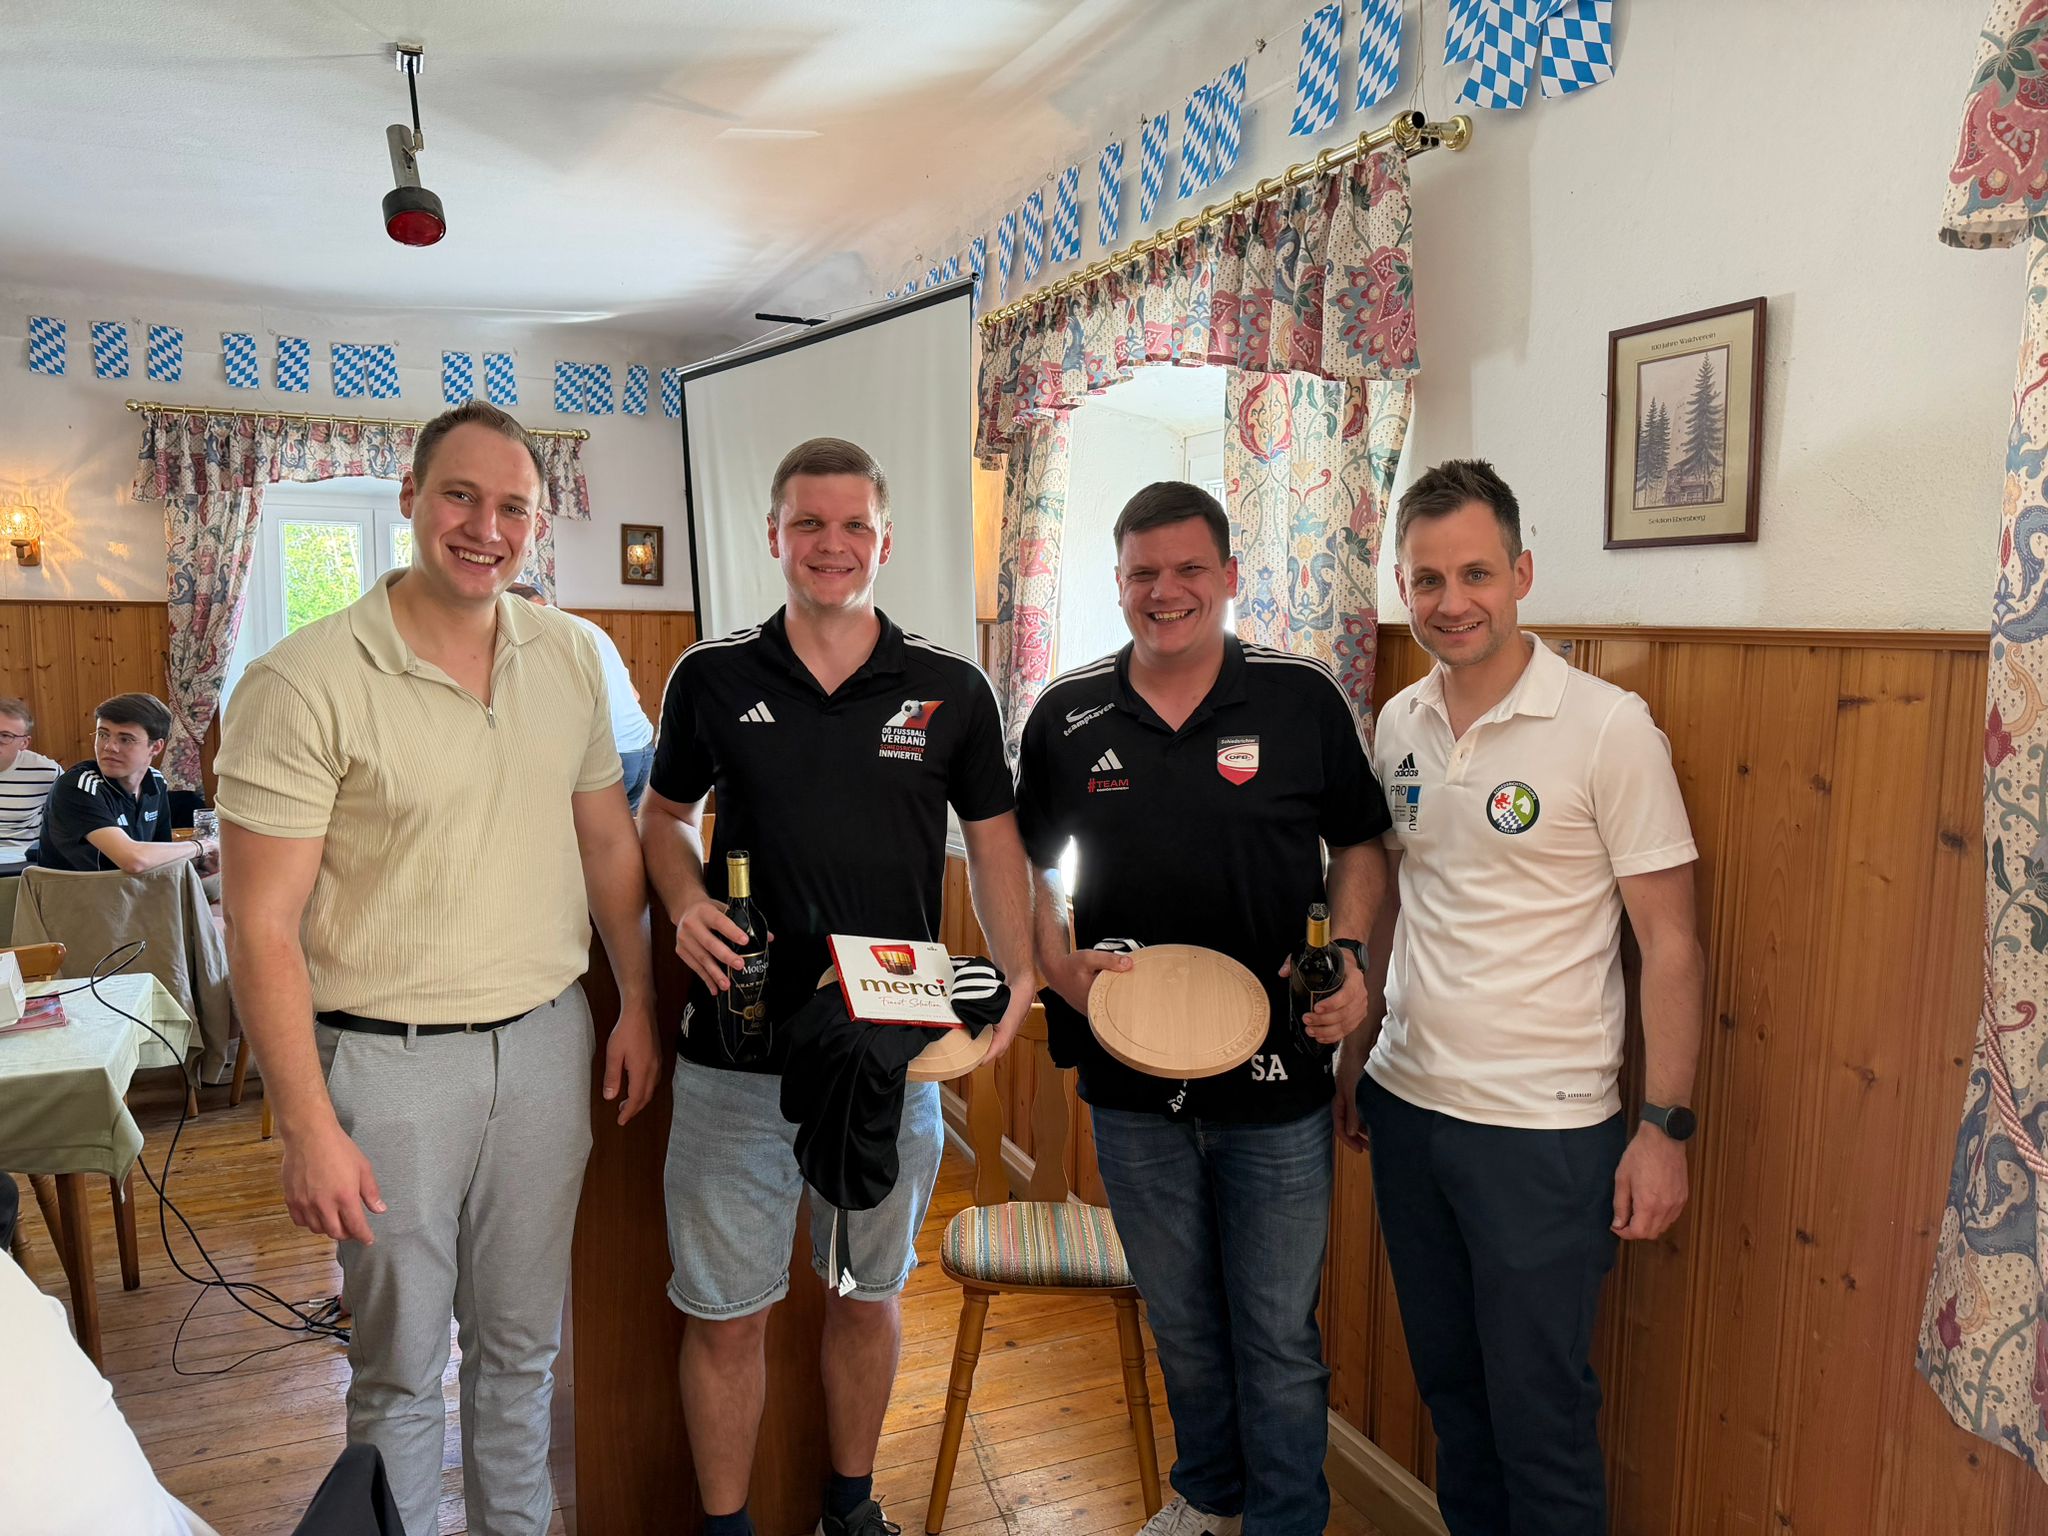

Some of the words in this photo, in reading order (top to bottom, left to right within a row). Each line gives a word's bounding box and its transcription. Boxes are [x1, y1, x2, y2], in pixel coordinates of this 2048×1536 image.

[881, 733, 926, 747] VERBAND
[893, 728, 926, 738] FUSSBALL
[878, 749, 924, 762] INNVIERTEL
[1394, 768, 1419, 778] adidas
[1088, 778, 1129, 793] #TEAM
[1390, 785, 1407, 796] PRO
[1408, 805, 1418, 831] BAU
[859, 978, 948, 998] merci
[1251, 1054, 1288, 1081] SA
